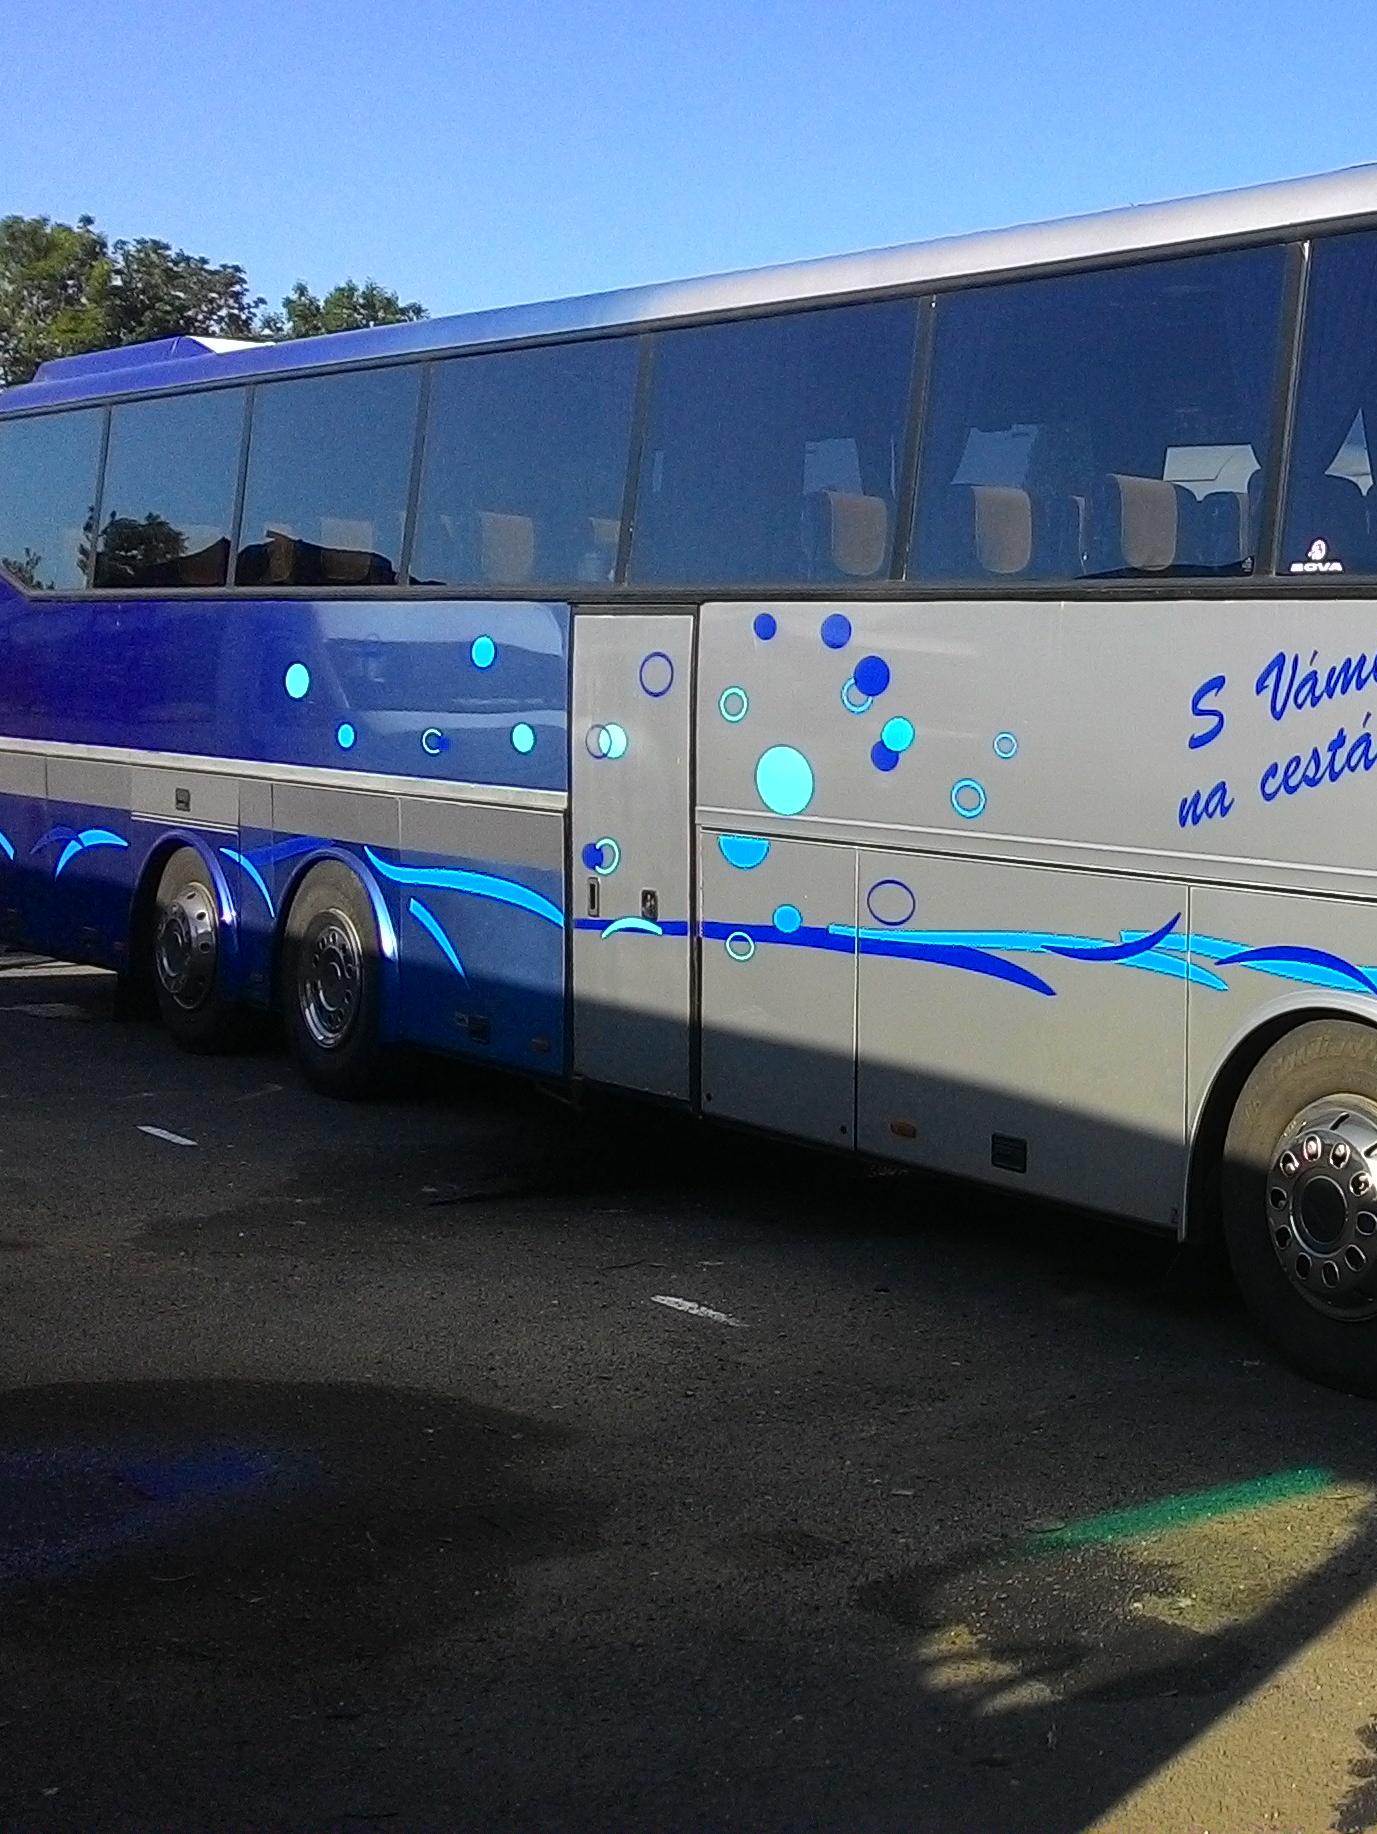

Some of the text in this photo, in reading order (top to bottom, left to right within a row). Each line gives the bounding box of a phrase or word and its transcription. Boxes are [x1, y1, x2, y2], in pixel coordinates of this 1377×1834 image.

[1290, 562, 1343, 572] BOVA
[1187, 675, 1226, 749] S
[1178, 780, 1235, 828] na
